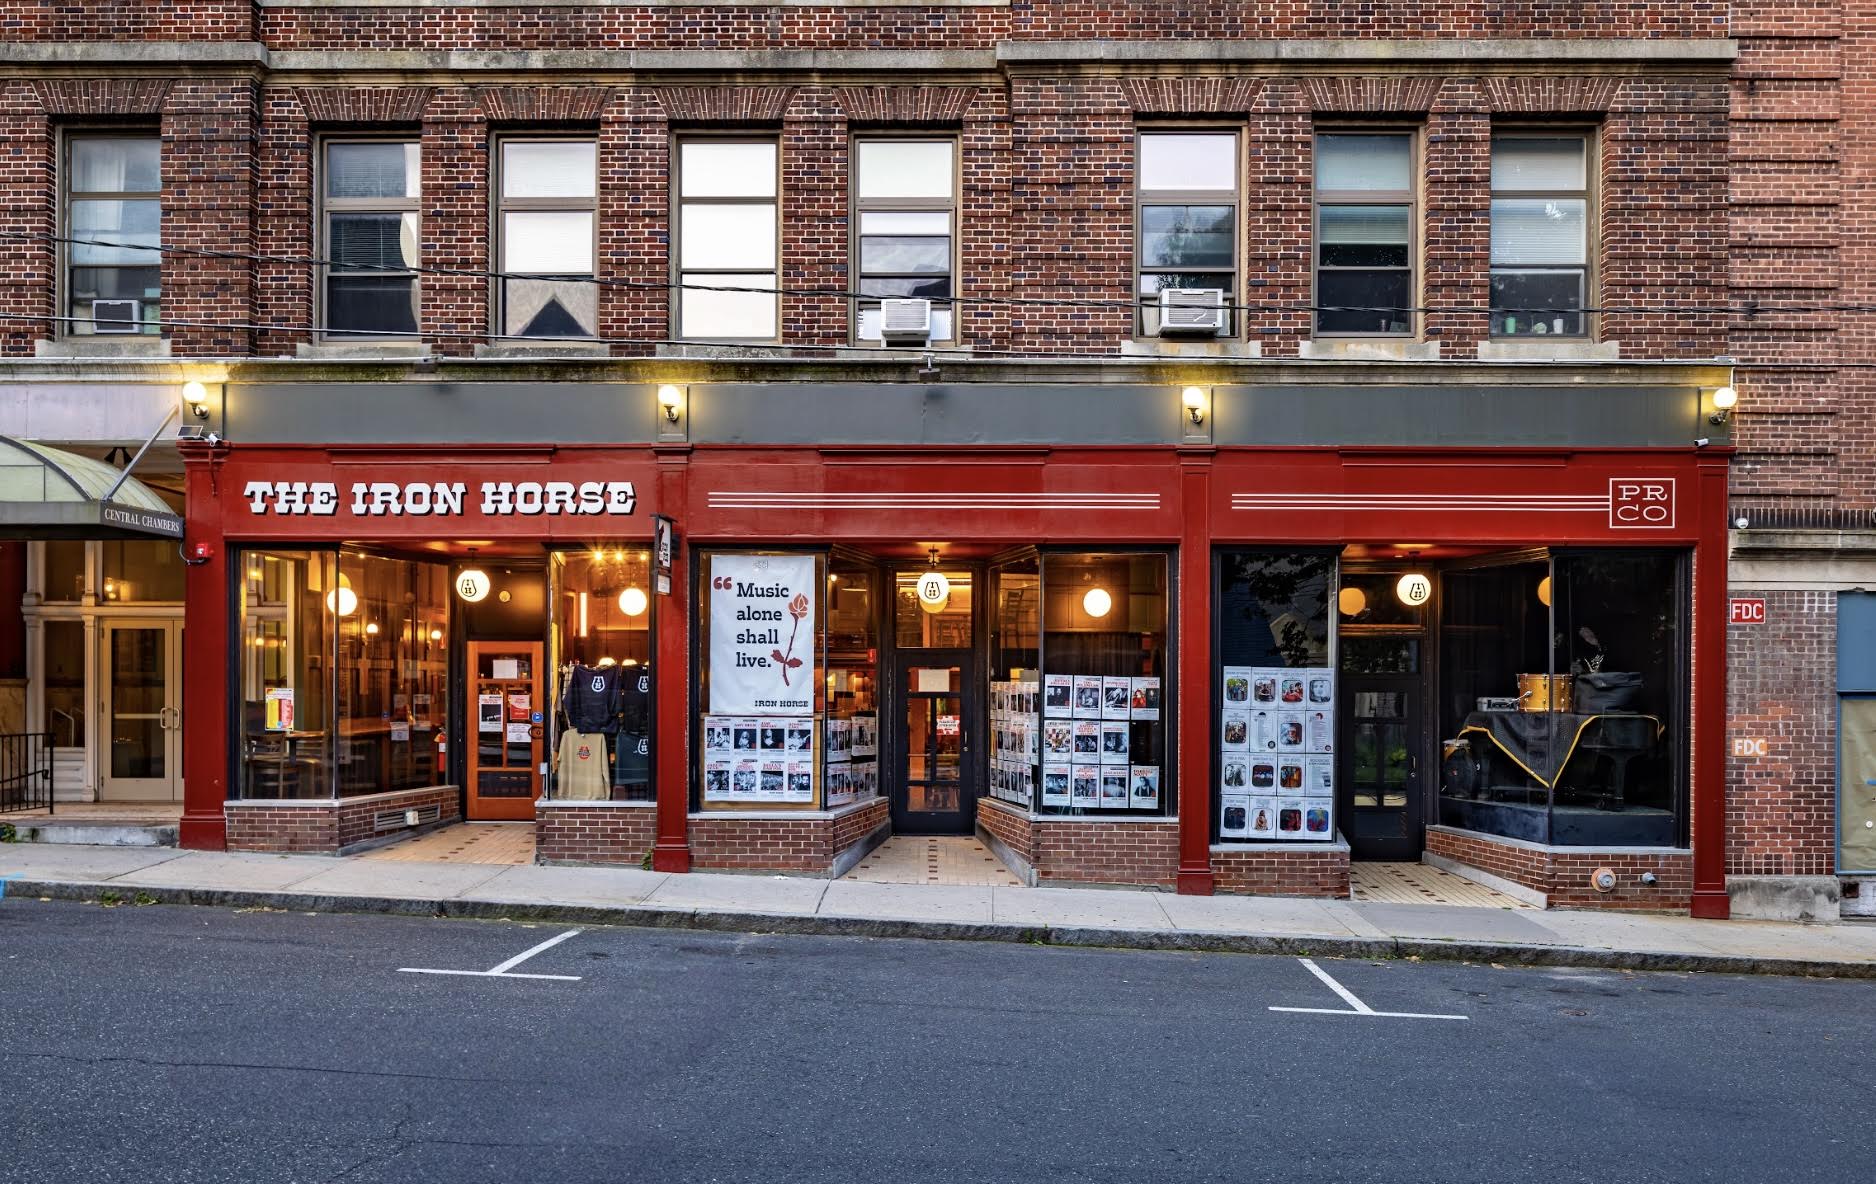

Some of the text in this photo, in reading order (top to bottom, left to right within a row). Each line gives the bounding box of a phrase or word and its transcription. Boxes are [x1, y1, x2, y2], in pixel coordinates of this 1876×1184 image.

[243, 481, 636, 516] THE IRON HORSE
[1617, 485, 1668, 501] PR
[104, 508, 180, 532] CENTRAL CHAMBERS
[1617, 504, 1667, 521] CO
[736, 605, 783, 621] alone
[1732, 602, 1763, 620] FDC
[736, 628, 780, 645] shall
[735, 651, 772, 668] live.
[754, 699, 809, 708] IRON HORSE
[1735, 738, 1766, 756] FDC
